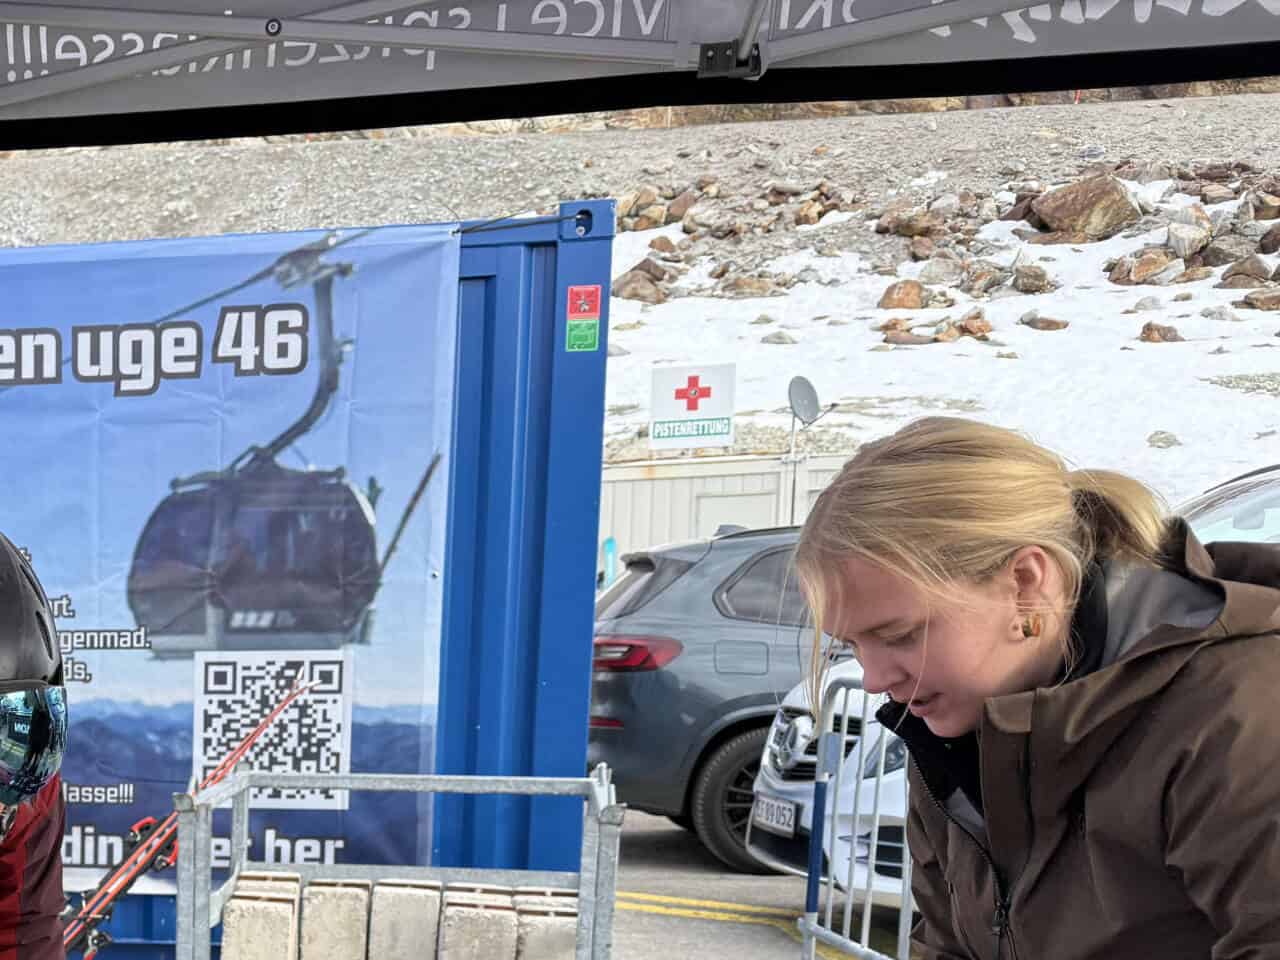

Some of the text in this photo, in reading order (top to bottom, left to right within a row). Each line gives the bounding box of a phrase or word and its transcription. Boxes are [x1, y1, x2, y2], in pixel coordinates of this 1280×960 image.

[75, 323, 199, 393] uge
[215, 307, 305, 373] 46
[654, 419, 729, 437] PISTENRETTUNG
[62, 782, 134, 803] lasse!!!
[264, 828, 345, 865] her
